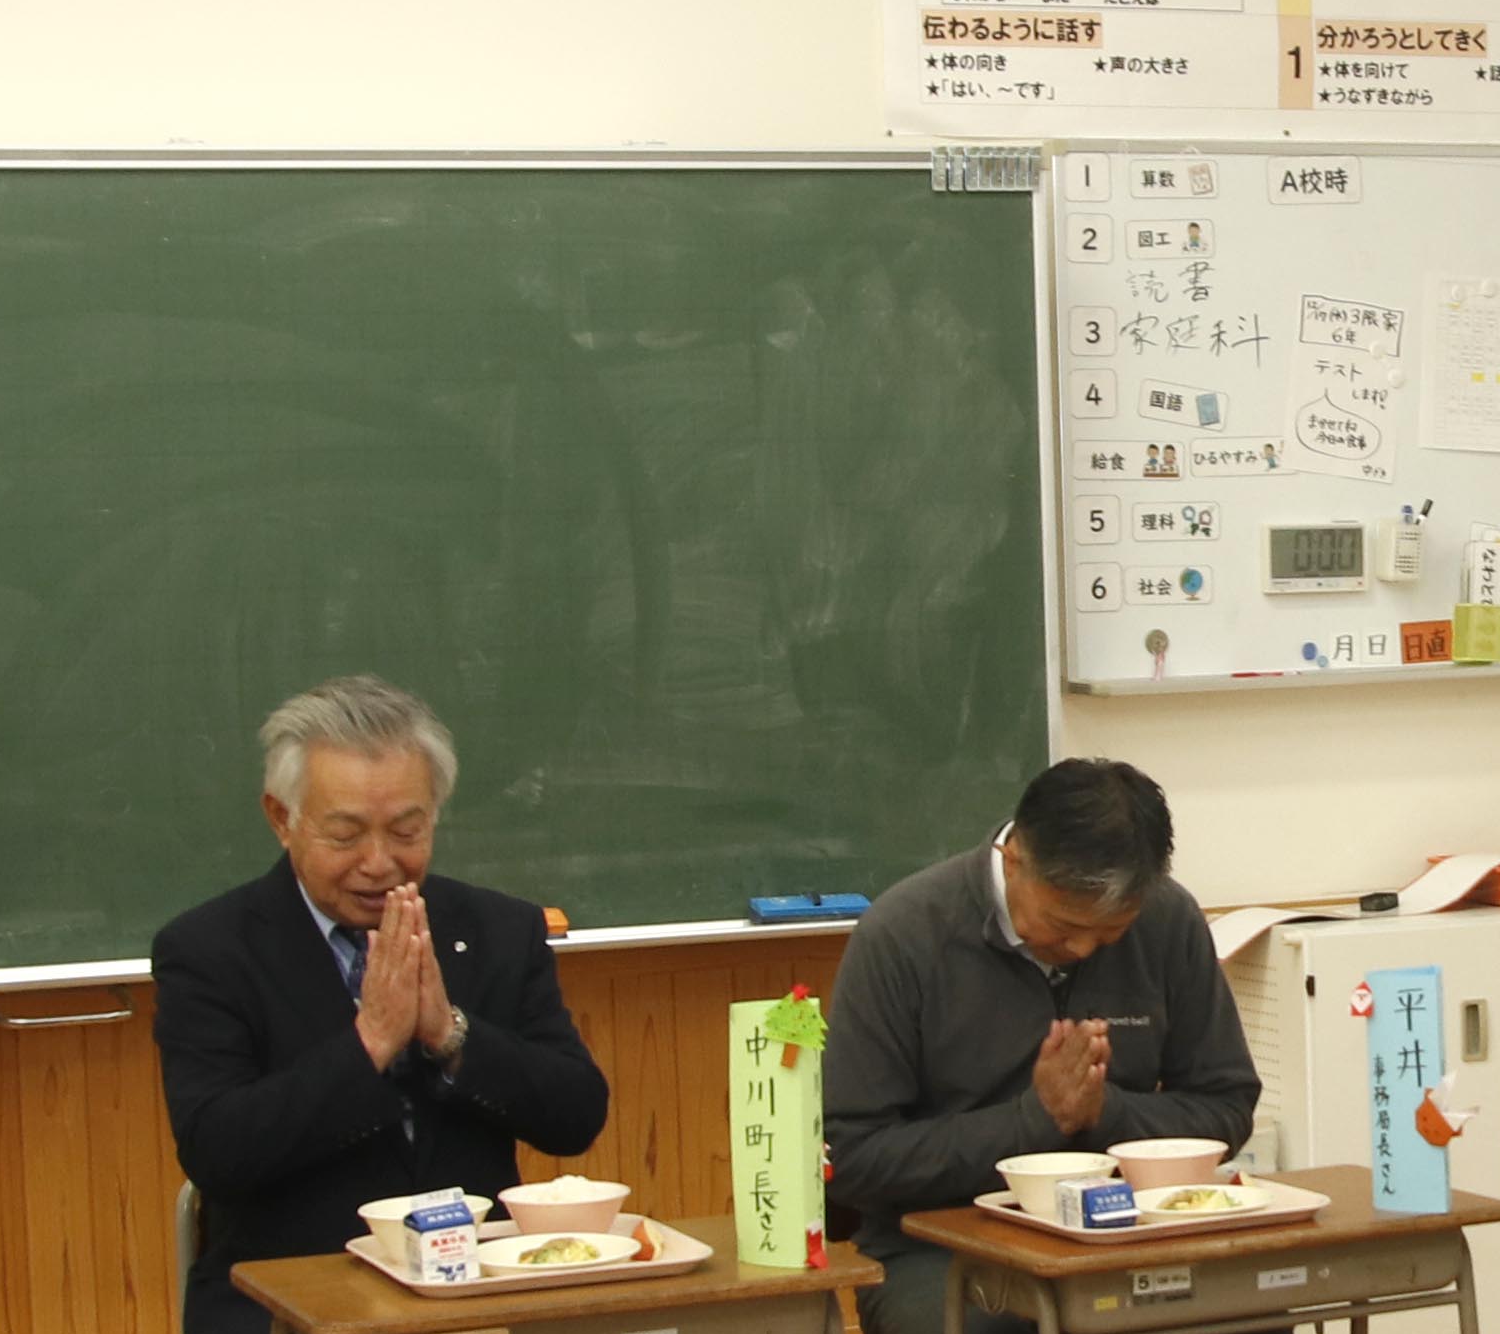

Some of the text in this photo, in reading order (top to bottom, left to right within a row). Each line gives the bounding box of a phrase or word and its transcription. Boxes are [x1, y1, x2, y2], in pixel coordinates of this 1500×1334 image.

[923, 17, 1101, 44] 伝わるように話す
[1317, 26, 1487, 52] 分かろうとしてきく
[941, 54, 1189, 75] 体の向き 声の大きさ
[1287, 45, 1302, 79] 1
[1334, 62, 1410, 79] 体を向けて
[1334, 88, 1434, 106] うなずきながら
[1083, 164, 1091, 188] 1
[1141, 169, 1176, 188] 算数
[1280, 168, 1349, 195] A校時
[1081, 227, 1098, 251] 2
[1138, 230, 1172, 248] 図工
[1085, 321, 1101, 345] 3
[1119, 312, 1271, 368] 家庭科
[1314, 359, 1363, 382] テスト
[1085, 383, 1103, 406] 4
[1149, 389, 1184, 413] 国語
[1090, 453, 1126, 472] 給食
[1193, 449, 1258, 466] ひるやすみ
[1089, 509, 1105, 533] 5
[1141, 513, 1175, 532] 理科
[1091, 576, 1107, 600] 6
[1138, 578, 1173, 596] 社会
[1333, 633, 1388, 662] 月 日
[1403, 629, 1449, 660] 日直
[1393, 987, 1428, 1088] 平井
[745, 1025, 779, 1253] 中川町長さん
